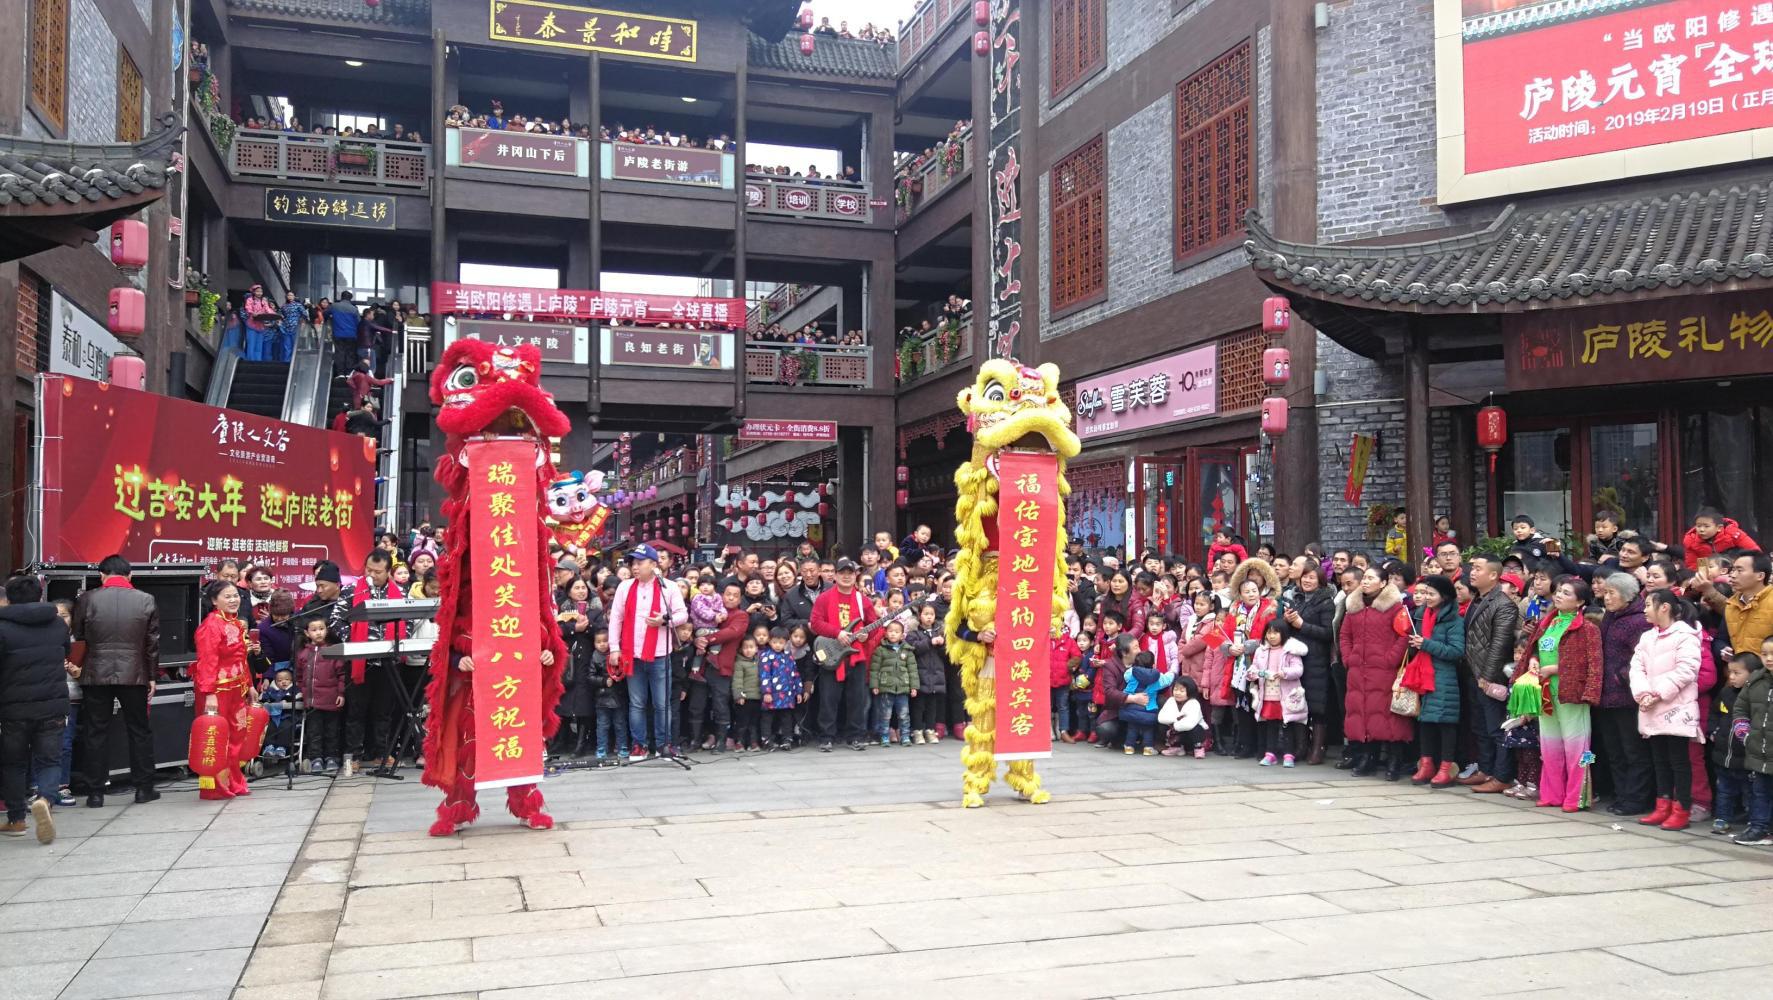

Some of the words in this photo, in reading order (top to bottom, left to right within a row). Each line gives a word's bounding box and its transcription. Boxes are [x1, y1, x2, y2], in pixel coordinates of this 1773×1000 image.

[497, 144, 566, 162] 井冈山下后
[623, 155, 689, 172] 庐陵老街游
[789, 194, 808, 206] 培训
[836, 199, 856, 210] 学校
[496, 334, 559, 350] 人文庐陵
[1581, 310, 1773, 363] 庐陵礼物
[624, 341, 684, 355] 良知老街
[1110, 373, 1169, 413] 雪芙蓉
[114, 463, 247, 528] 过吉安大年
[260, 482, 353, 530] 逛庐陵老街
[207, 536, 231, 551] 迎新年
[232, 538, 254, 553] 逛老街
[487, 462, 526, 761] 瑞聚佳处笑迎八方祝福
[1009, 472, 1041, 737] 福佑宝地喜纳四海宾客
